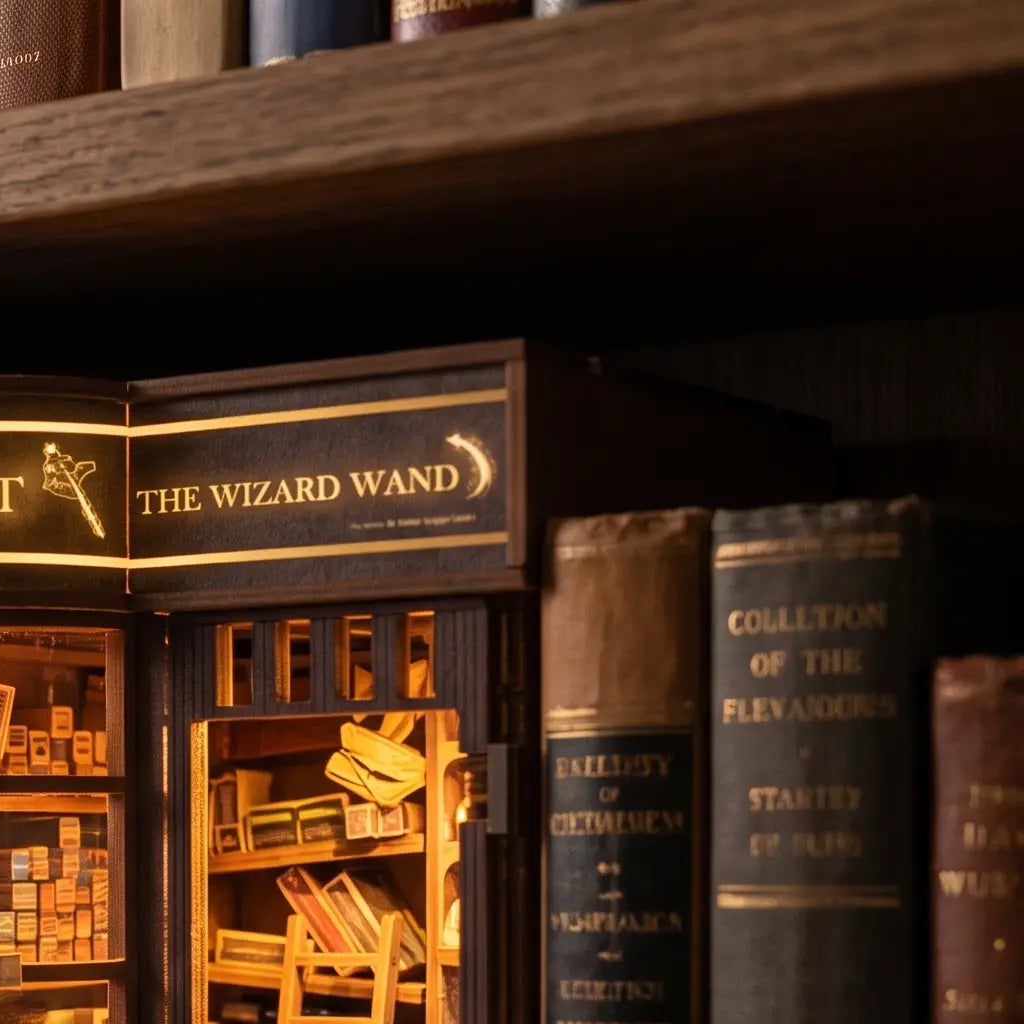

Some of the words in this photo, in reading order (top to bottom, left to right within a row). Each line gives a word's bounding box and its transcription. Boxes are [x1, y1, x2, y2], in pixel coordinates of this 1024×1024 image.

[136, 485, 203, 515] THE
[209, 474, 342, 509] WIZARD
[349, 463, 460, 498] WAND
